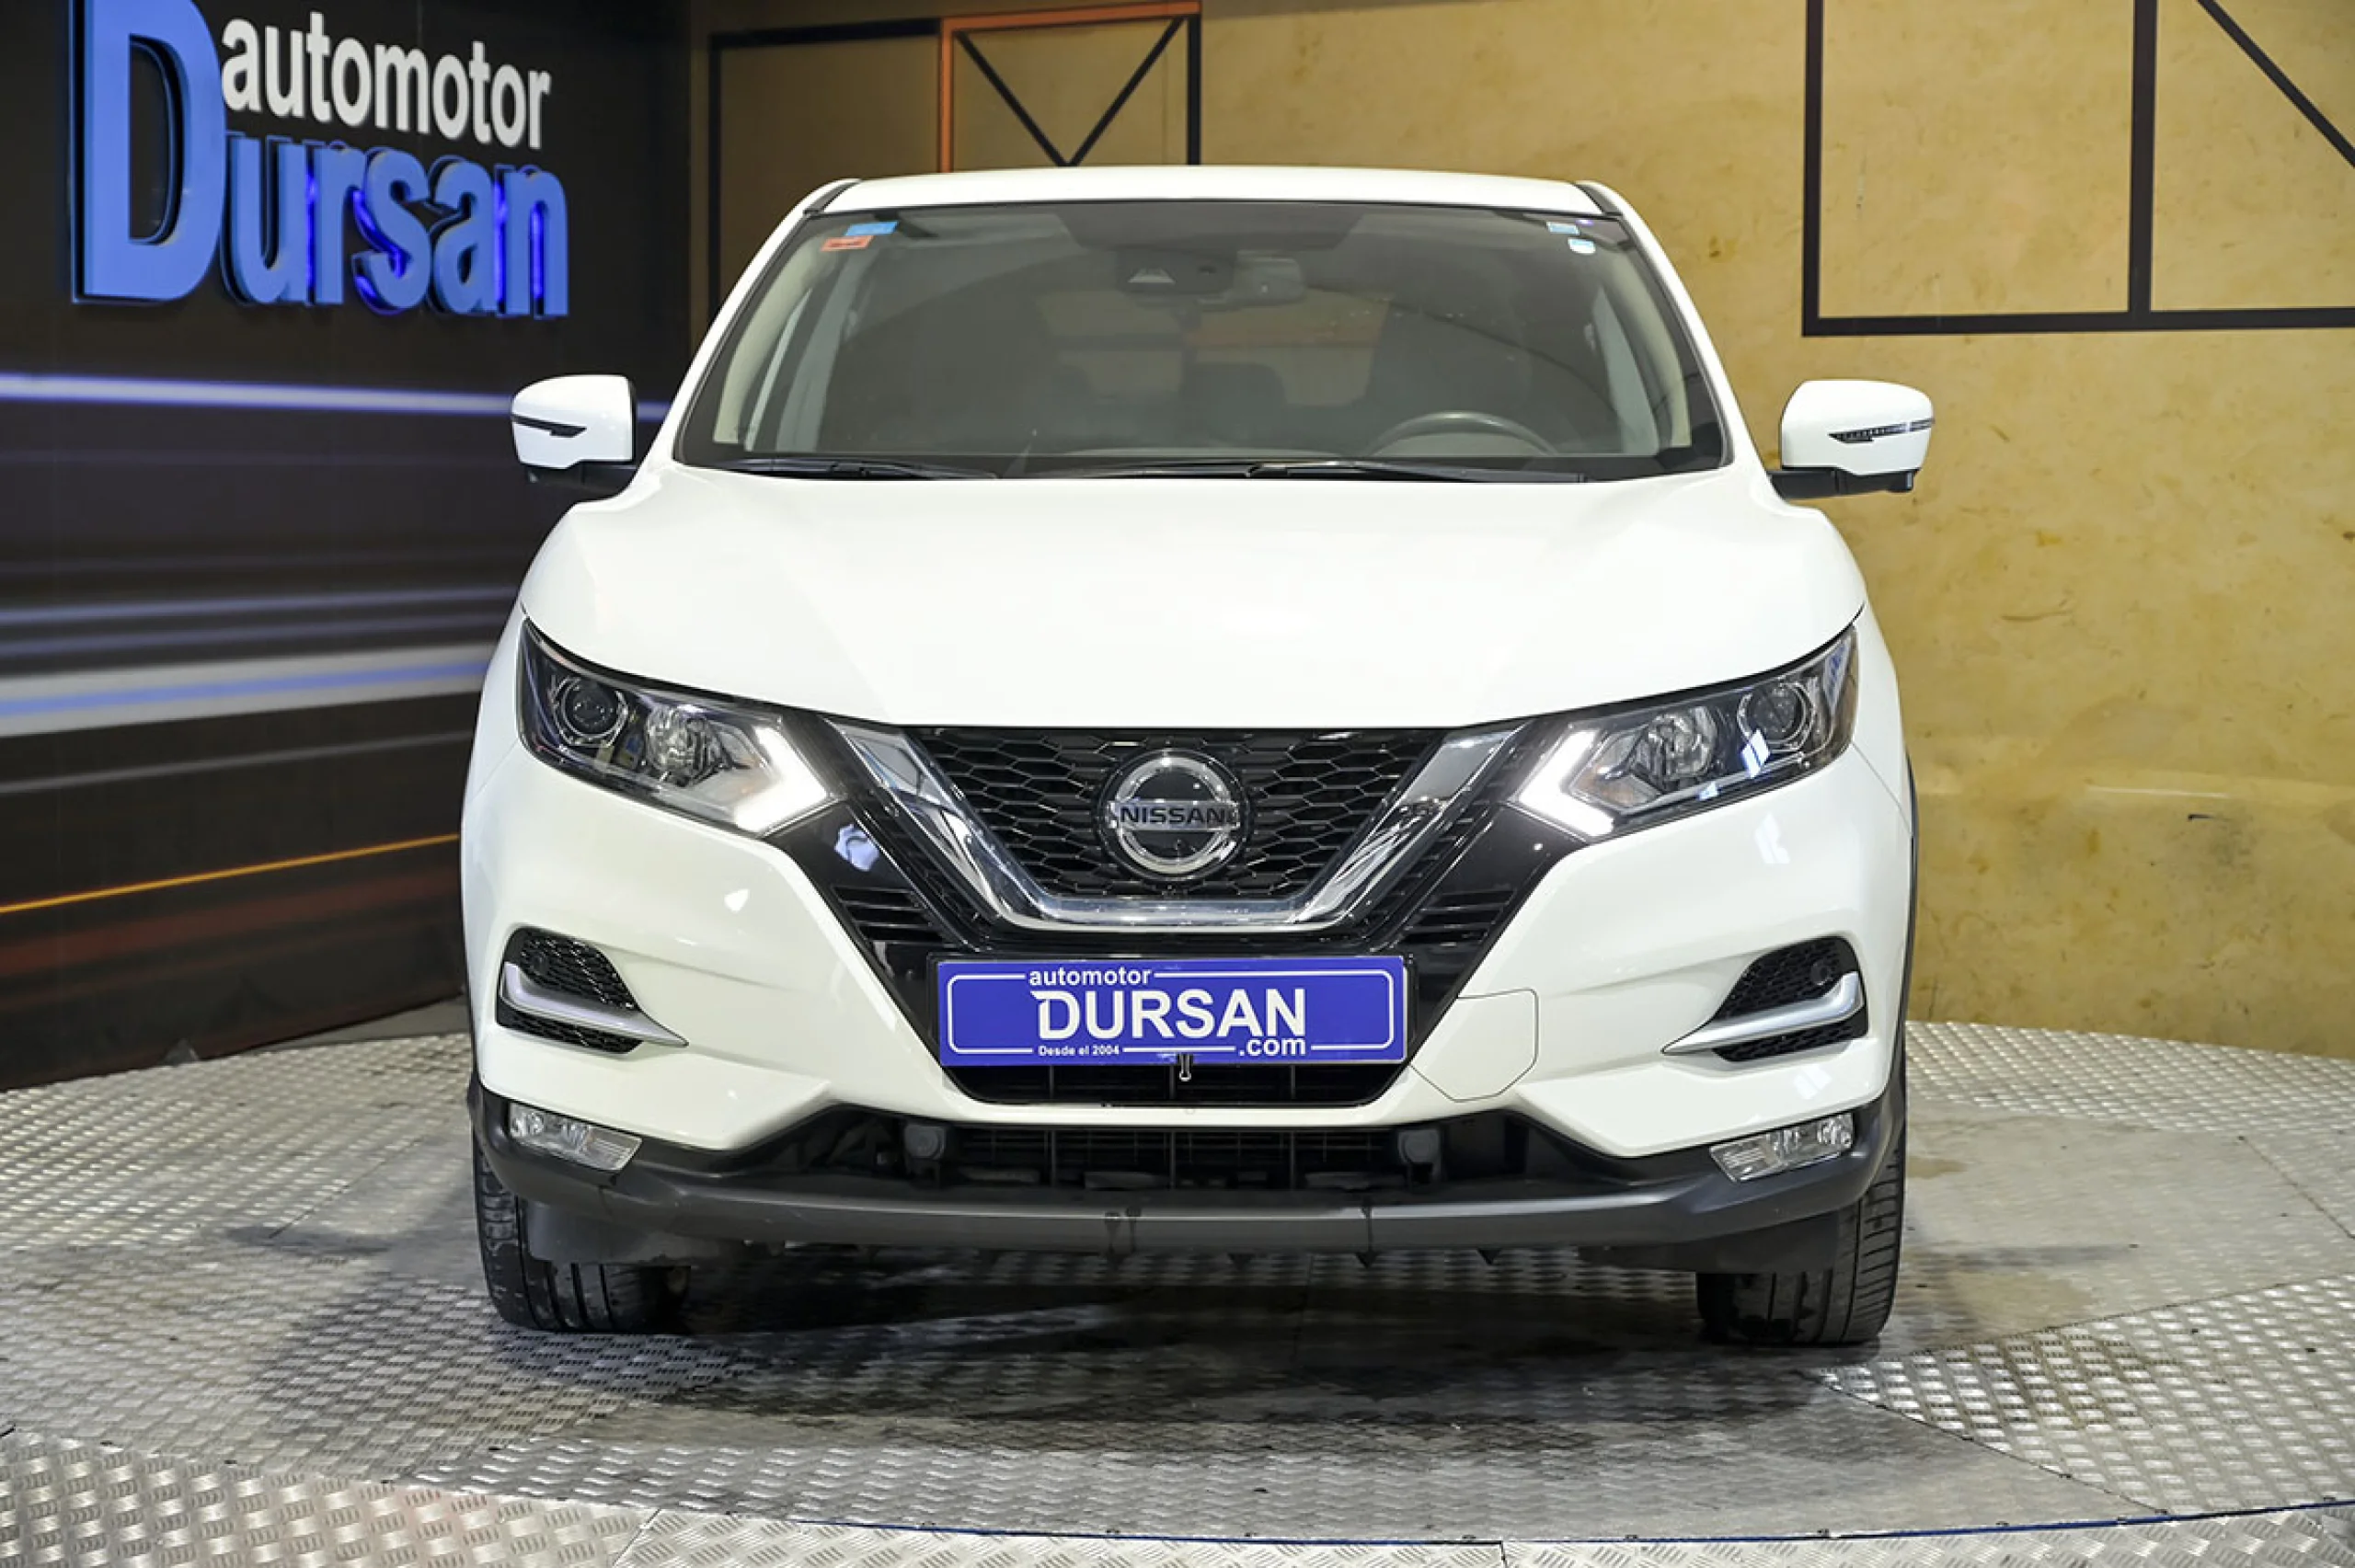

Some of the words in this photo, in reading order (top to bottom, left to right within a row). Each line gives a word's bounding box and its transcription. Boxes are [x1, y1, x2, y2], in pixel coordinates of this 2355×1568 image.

[221, 11, 551, 149] automotor
[73, 0, 569, 318] Dursan
[1120, 807, 1225, 823] NISSAN
[1029, 967, 1152, 986] automotor
[1030, 988, 1306, 1039] DURSAN
[1038, 1045, 1075, 1056] Desde
[1079, 1045, 1089, 1055] el
[1092, 1045, 1120, 1056] 2004
[1238, 1036, 1306, 1057] .com
